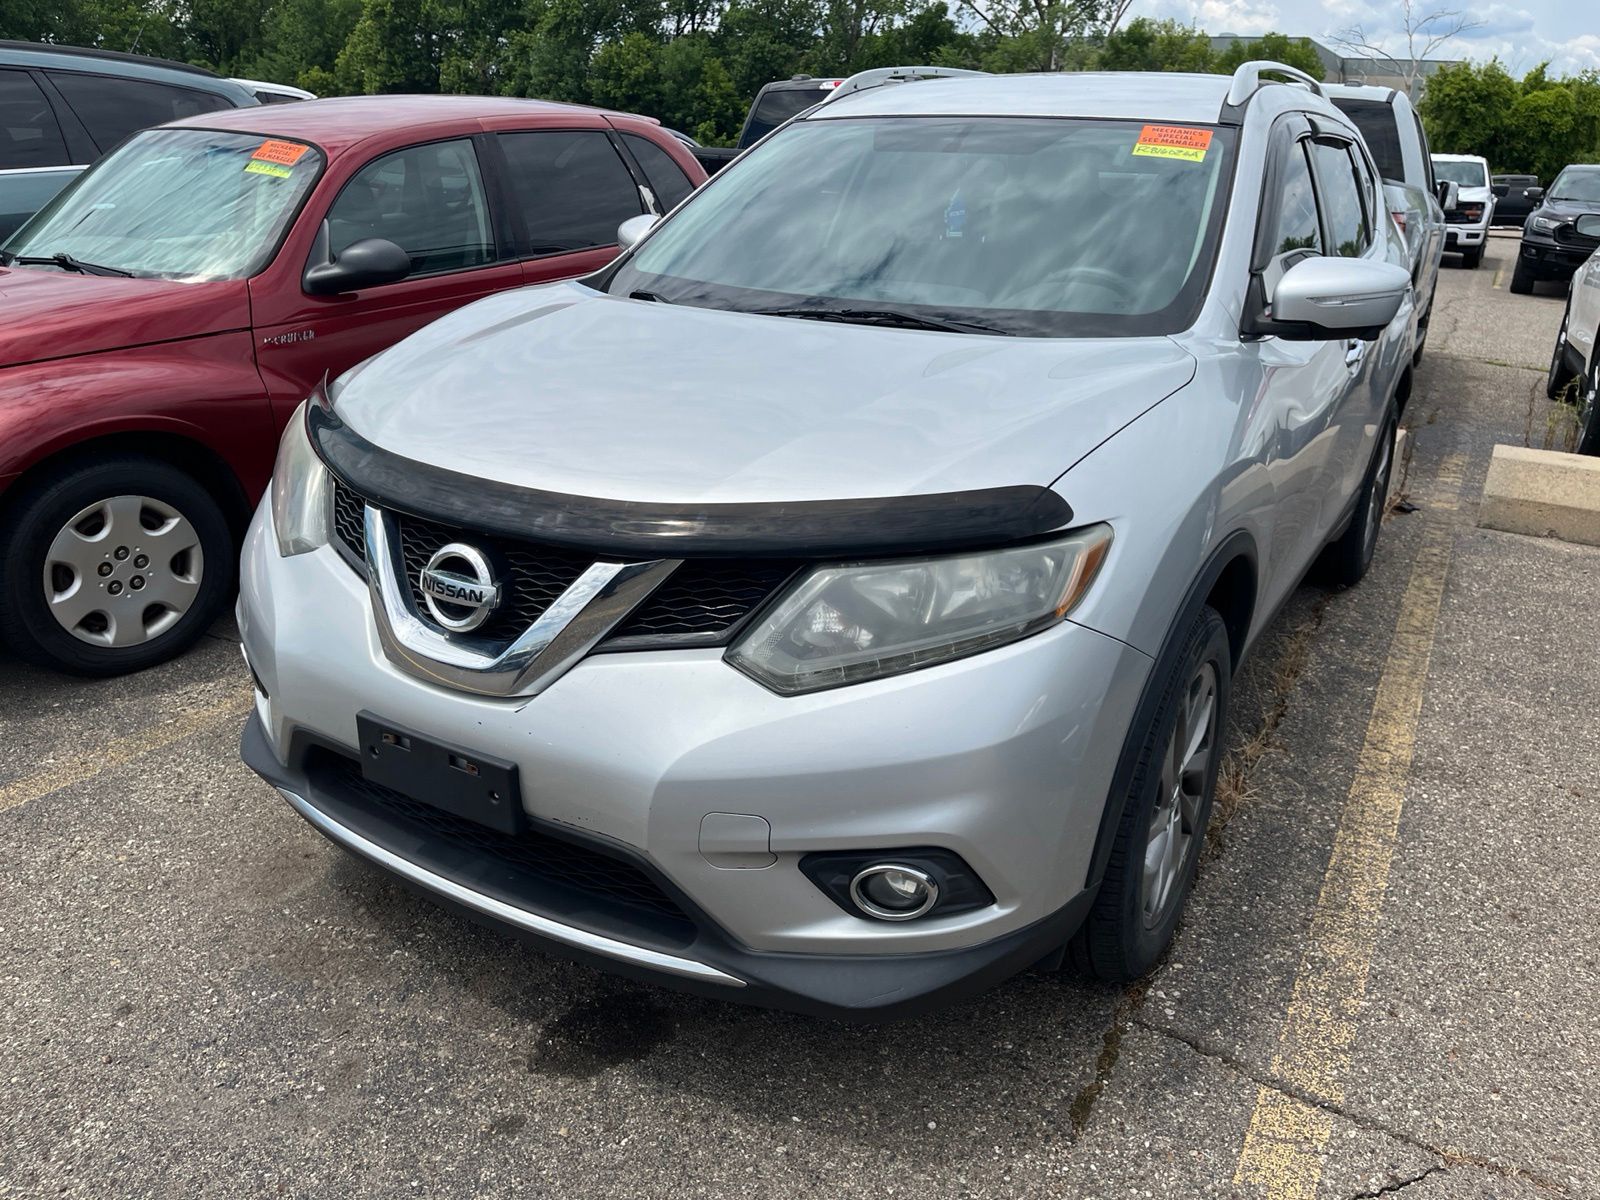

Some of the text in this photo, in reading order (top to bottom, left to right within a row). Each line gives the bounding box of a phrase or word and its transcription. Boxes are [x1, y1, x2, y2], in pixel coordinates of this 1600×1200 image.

[1152, 127, 1203, 136] MECHANICS
[1157, 133, 1193, 141] SPECIAL
[1161, 138, 1207, 148] MANAGER
[423, 575, 483, 603] NISSAN
